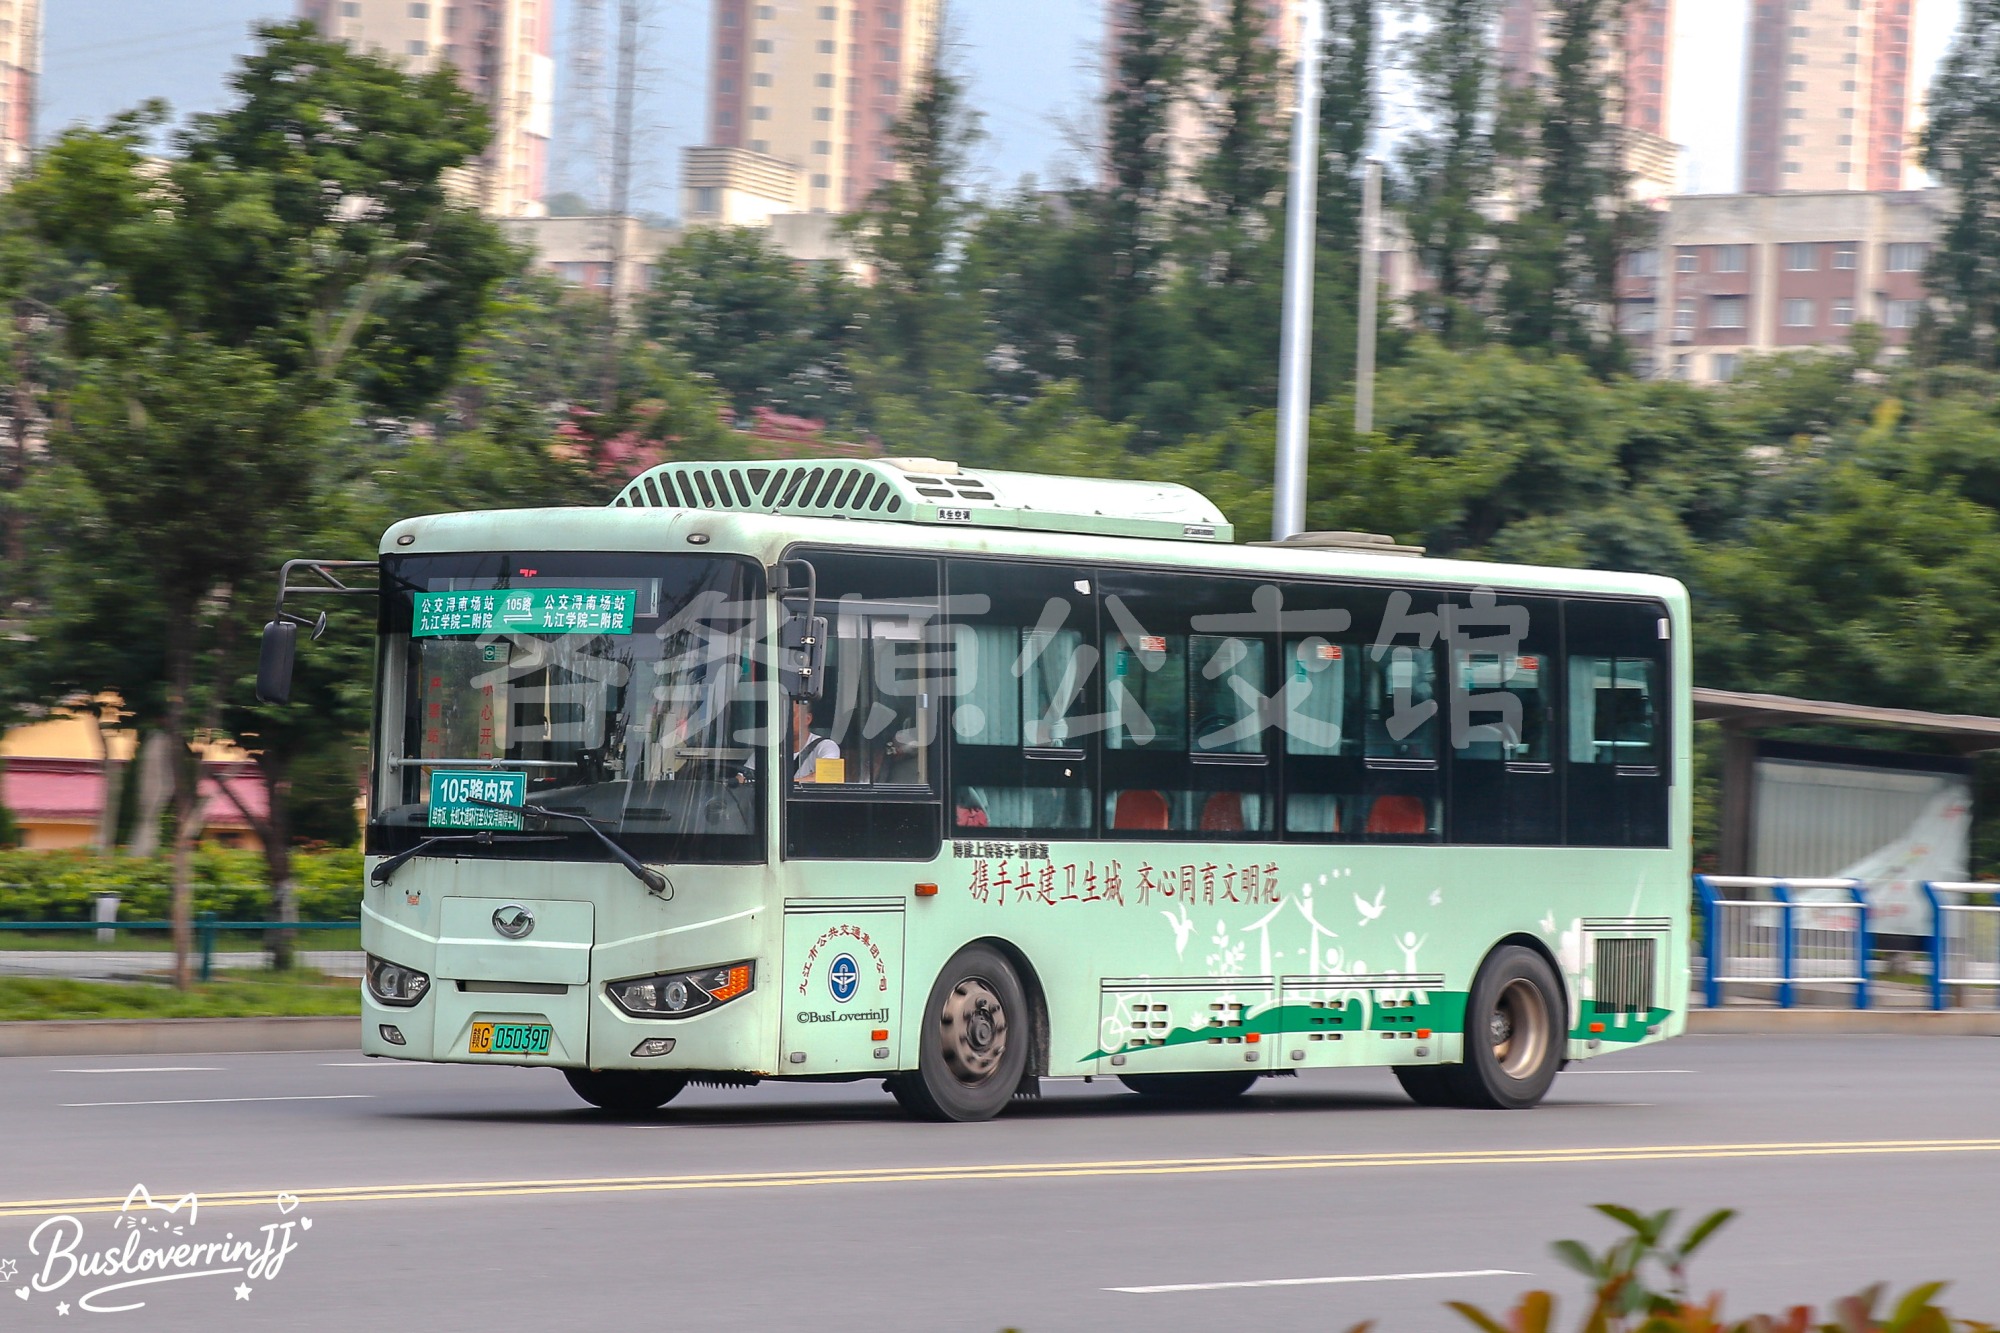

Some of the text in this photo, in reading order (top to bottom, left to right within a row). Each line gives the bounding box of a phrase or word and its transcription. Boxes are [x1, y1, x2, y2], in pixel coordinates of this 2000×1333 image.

[421, 595, 495, 613] 公交浔南场站
[506, 597, 532, 612] 105路
[544, 594, 626, 611] 公交浔南场站
[420, 613, 493, 631] 九江学院二附院
[542, 611, 624, 630] 九江学院二附院
[440, 778, 514, 804] 105路内环
[969, 858, 1281, 907] 携手共建卫生城 齐心同育文明花
[799, 924, 887, 996] 九江市公共交通集团公司
